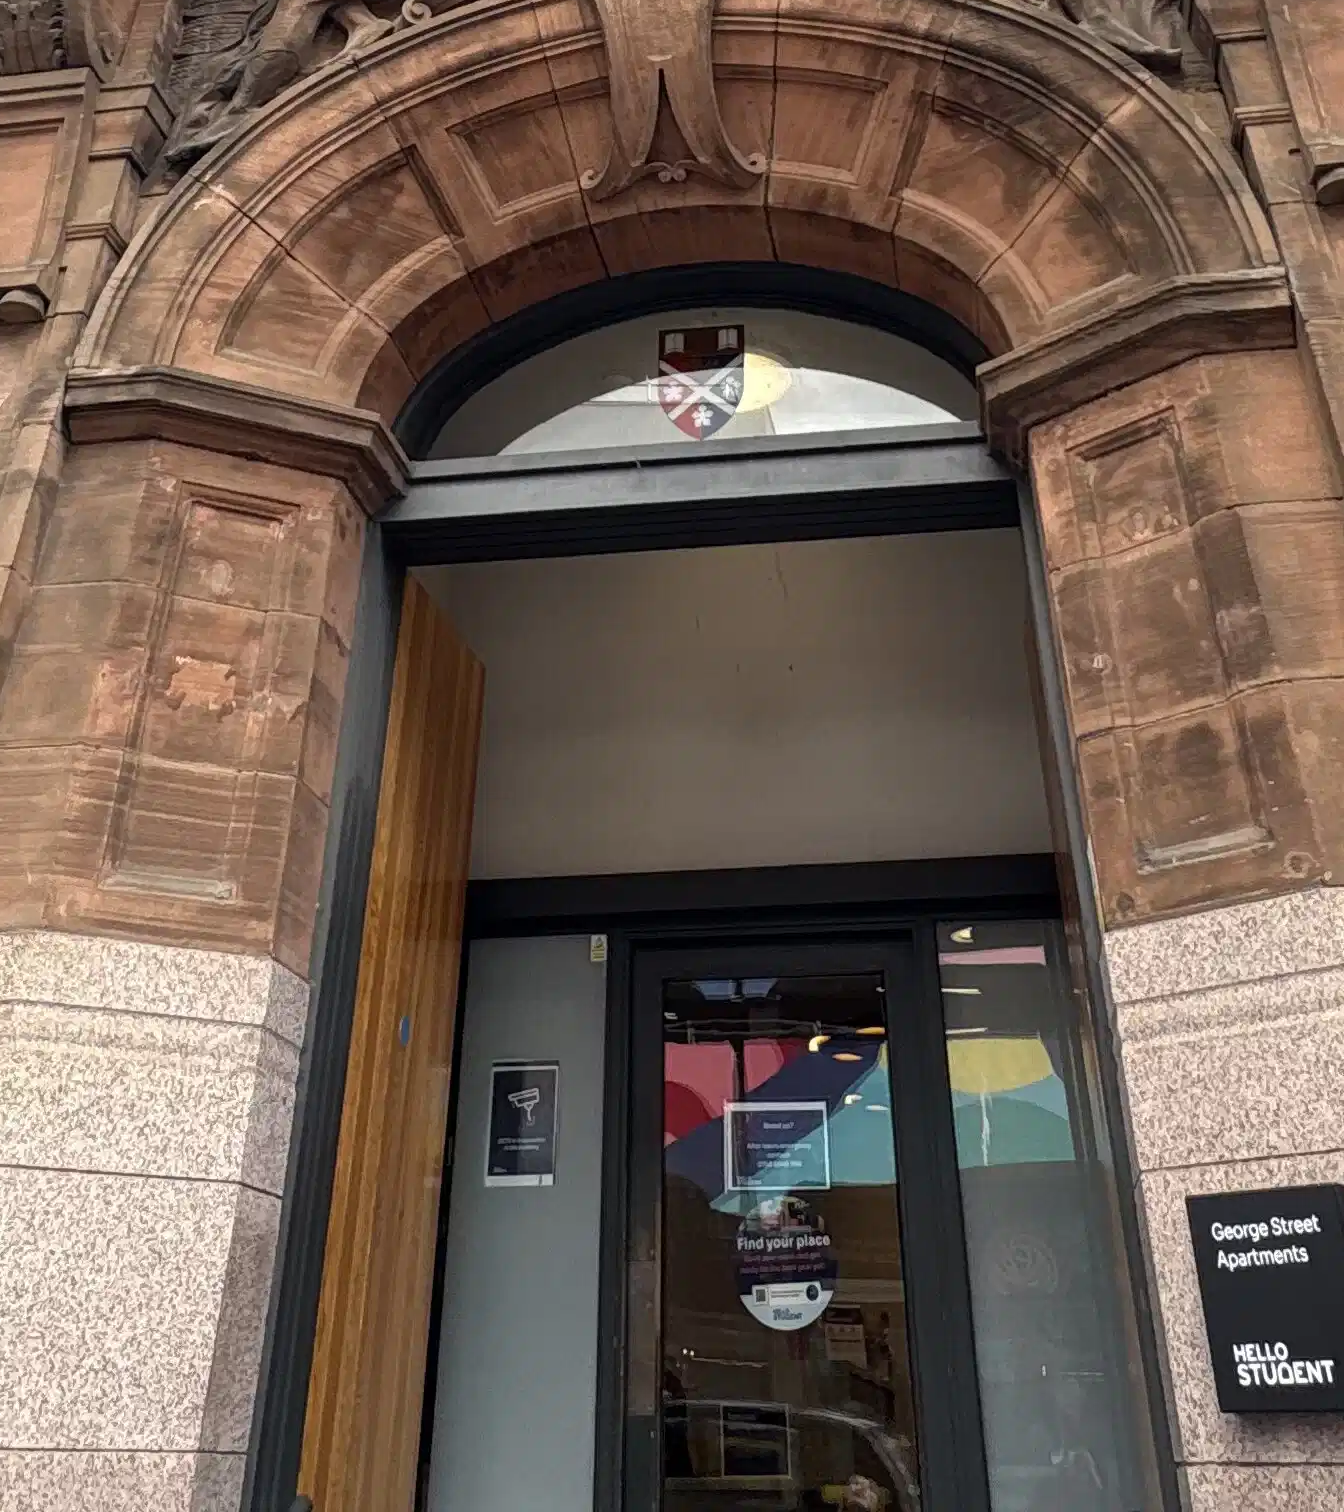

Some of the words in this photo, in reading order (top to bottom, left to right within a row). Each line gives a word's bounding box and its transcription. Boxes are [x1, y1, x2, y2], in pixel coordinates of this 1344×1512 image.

[1211, 1220, 1269, 1243] George
[1270, 1214, 1322, 1237] Street
[736, 1236, 765, 1251] Find
[766, 1236, 794, 1252] your
[796, 1234, 831, 1250] place
[1216, 1244, 1310, 1272] Apartments
[1232, 1341, 1289, 1363] HELLO
[1236, 1360, 1336, 1387] STUDENT
